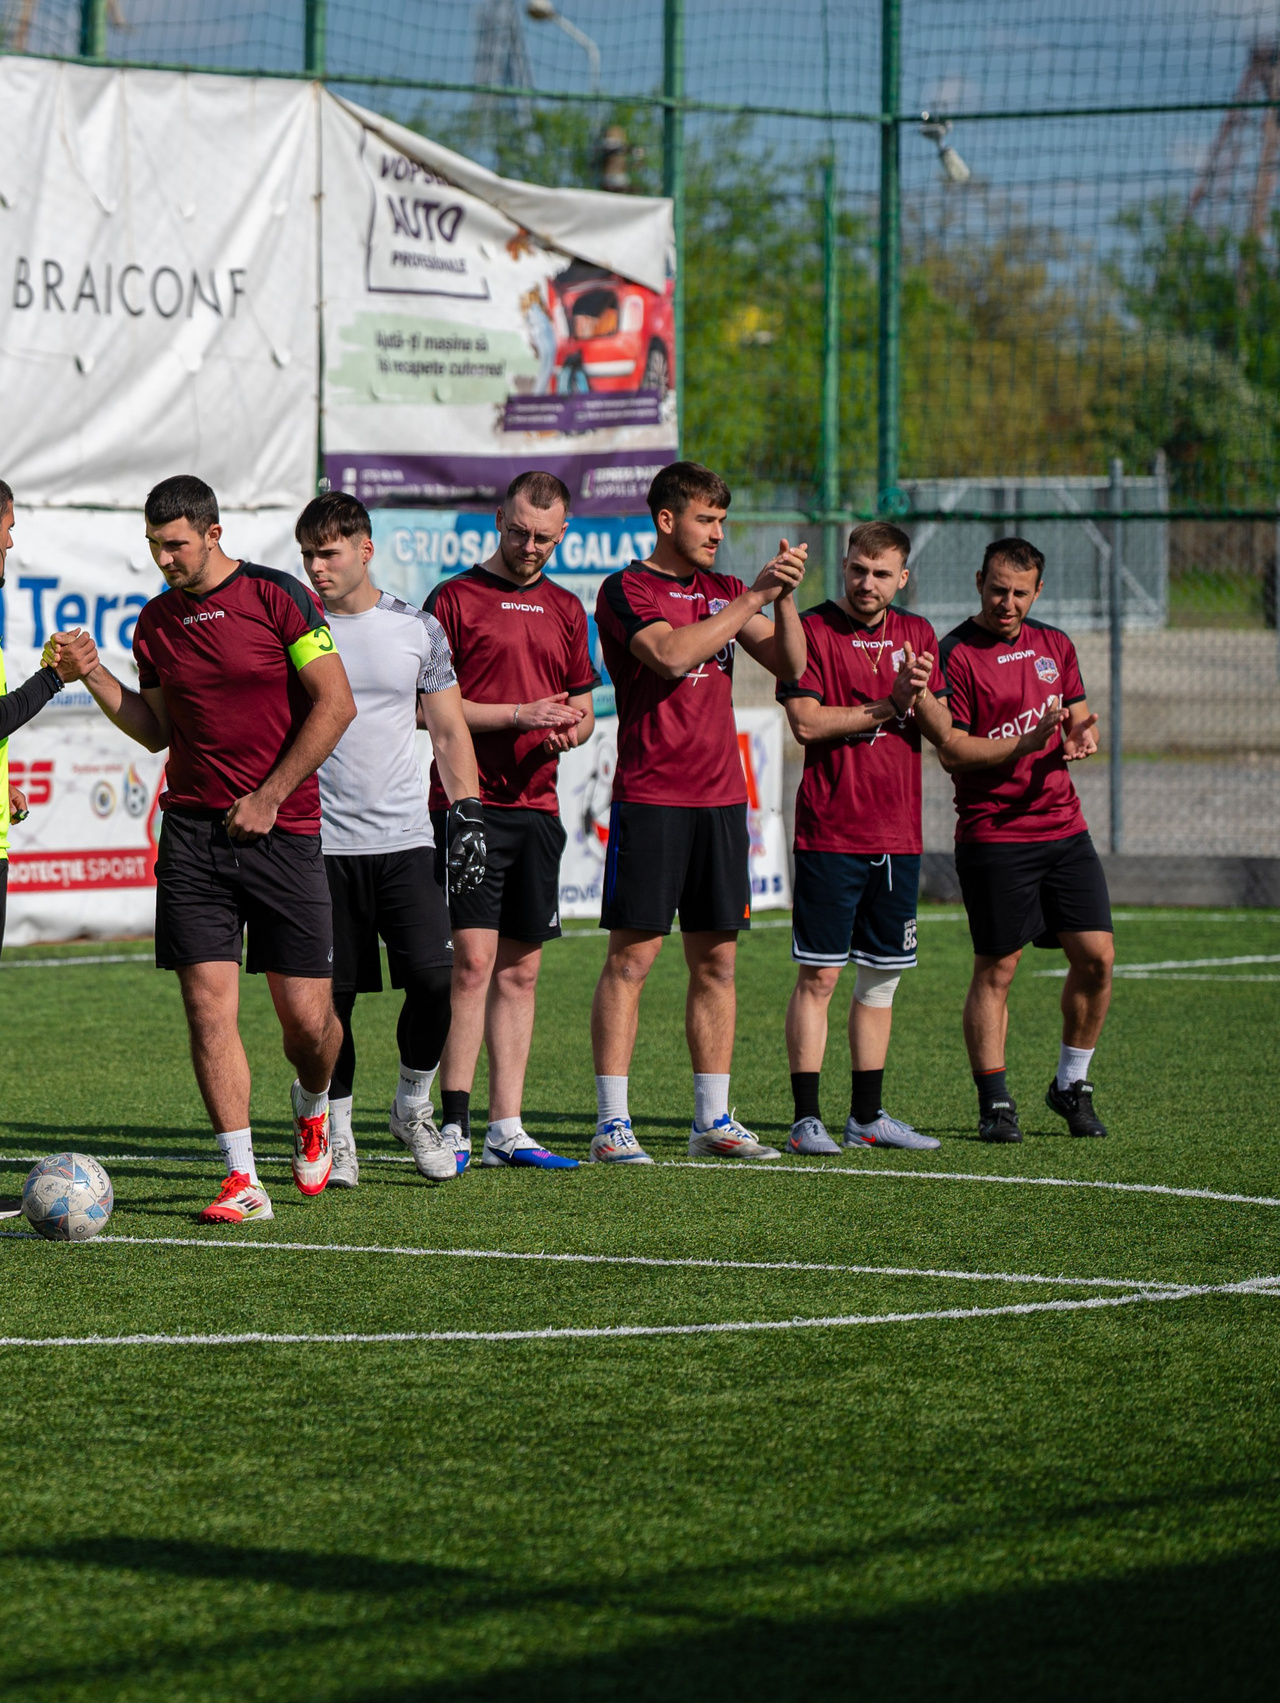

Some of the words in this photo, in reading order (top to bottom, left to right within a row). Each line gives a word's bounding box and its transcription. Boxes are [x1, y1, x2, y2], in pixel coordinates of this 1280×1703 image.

[387, 194, 465, 244] AUTO
[12, 255, 247, 320] BRAICONF
[501, 602, 544, 614] GIVOVA
[183, 610, 225, 625] GIVOVA
[852, 639, 894, 649] GIVOVA
[996, 649, 1036, 665] GIVOVA
[86, 855, 147, 881] SPORT
